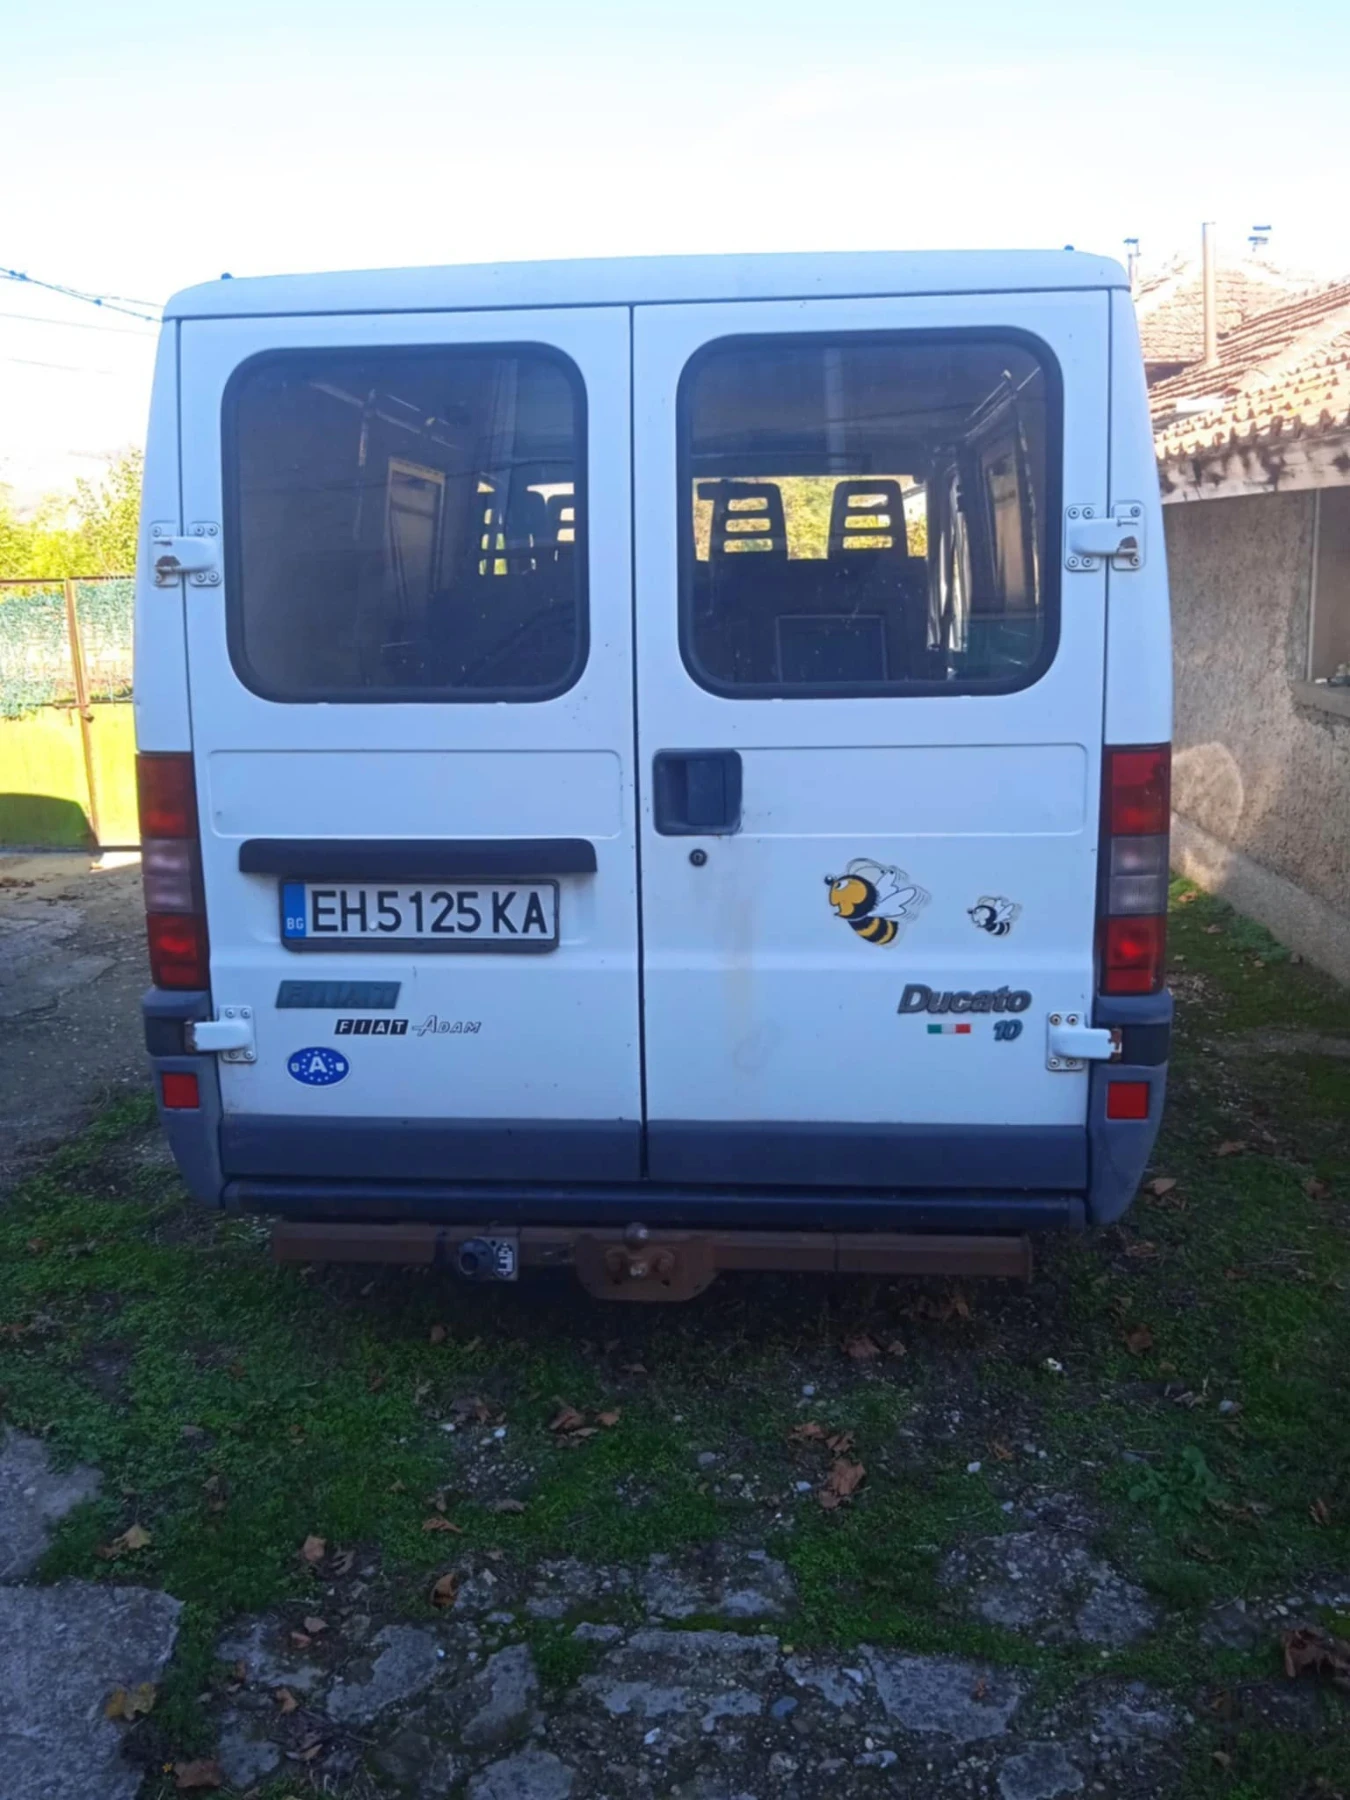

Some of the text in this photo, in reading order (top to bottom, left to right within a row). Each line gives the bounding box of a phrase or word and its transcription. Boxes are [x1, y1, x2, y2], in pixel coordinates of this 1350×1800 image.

[286, 917, 304, 930] BG
[898, 984, 1032, 1014] Ducato
[336, 1020, 407, 1034] FIAT
[993, 1019, 1023, 1042] 10
[308, 1056, 328, 1073] A
